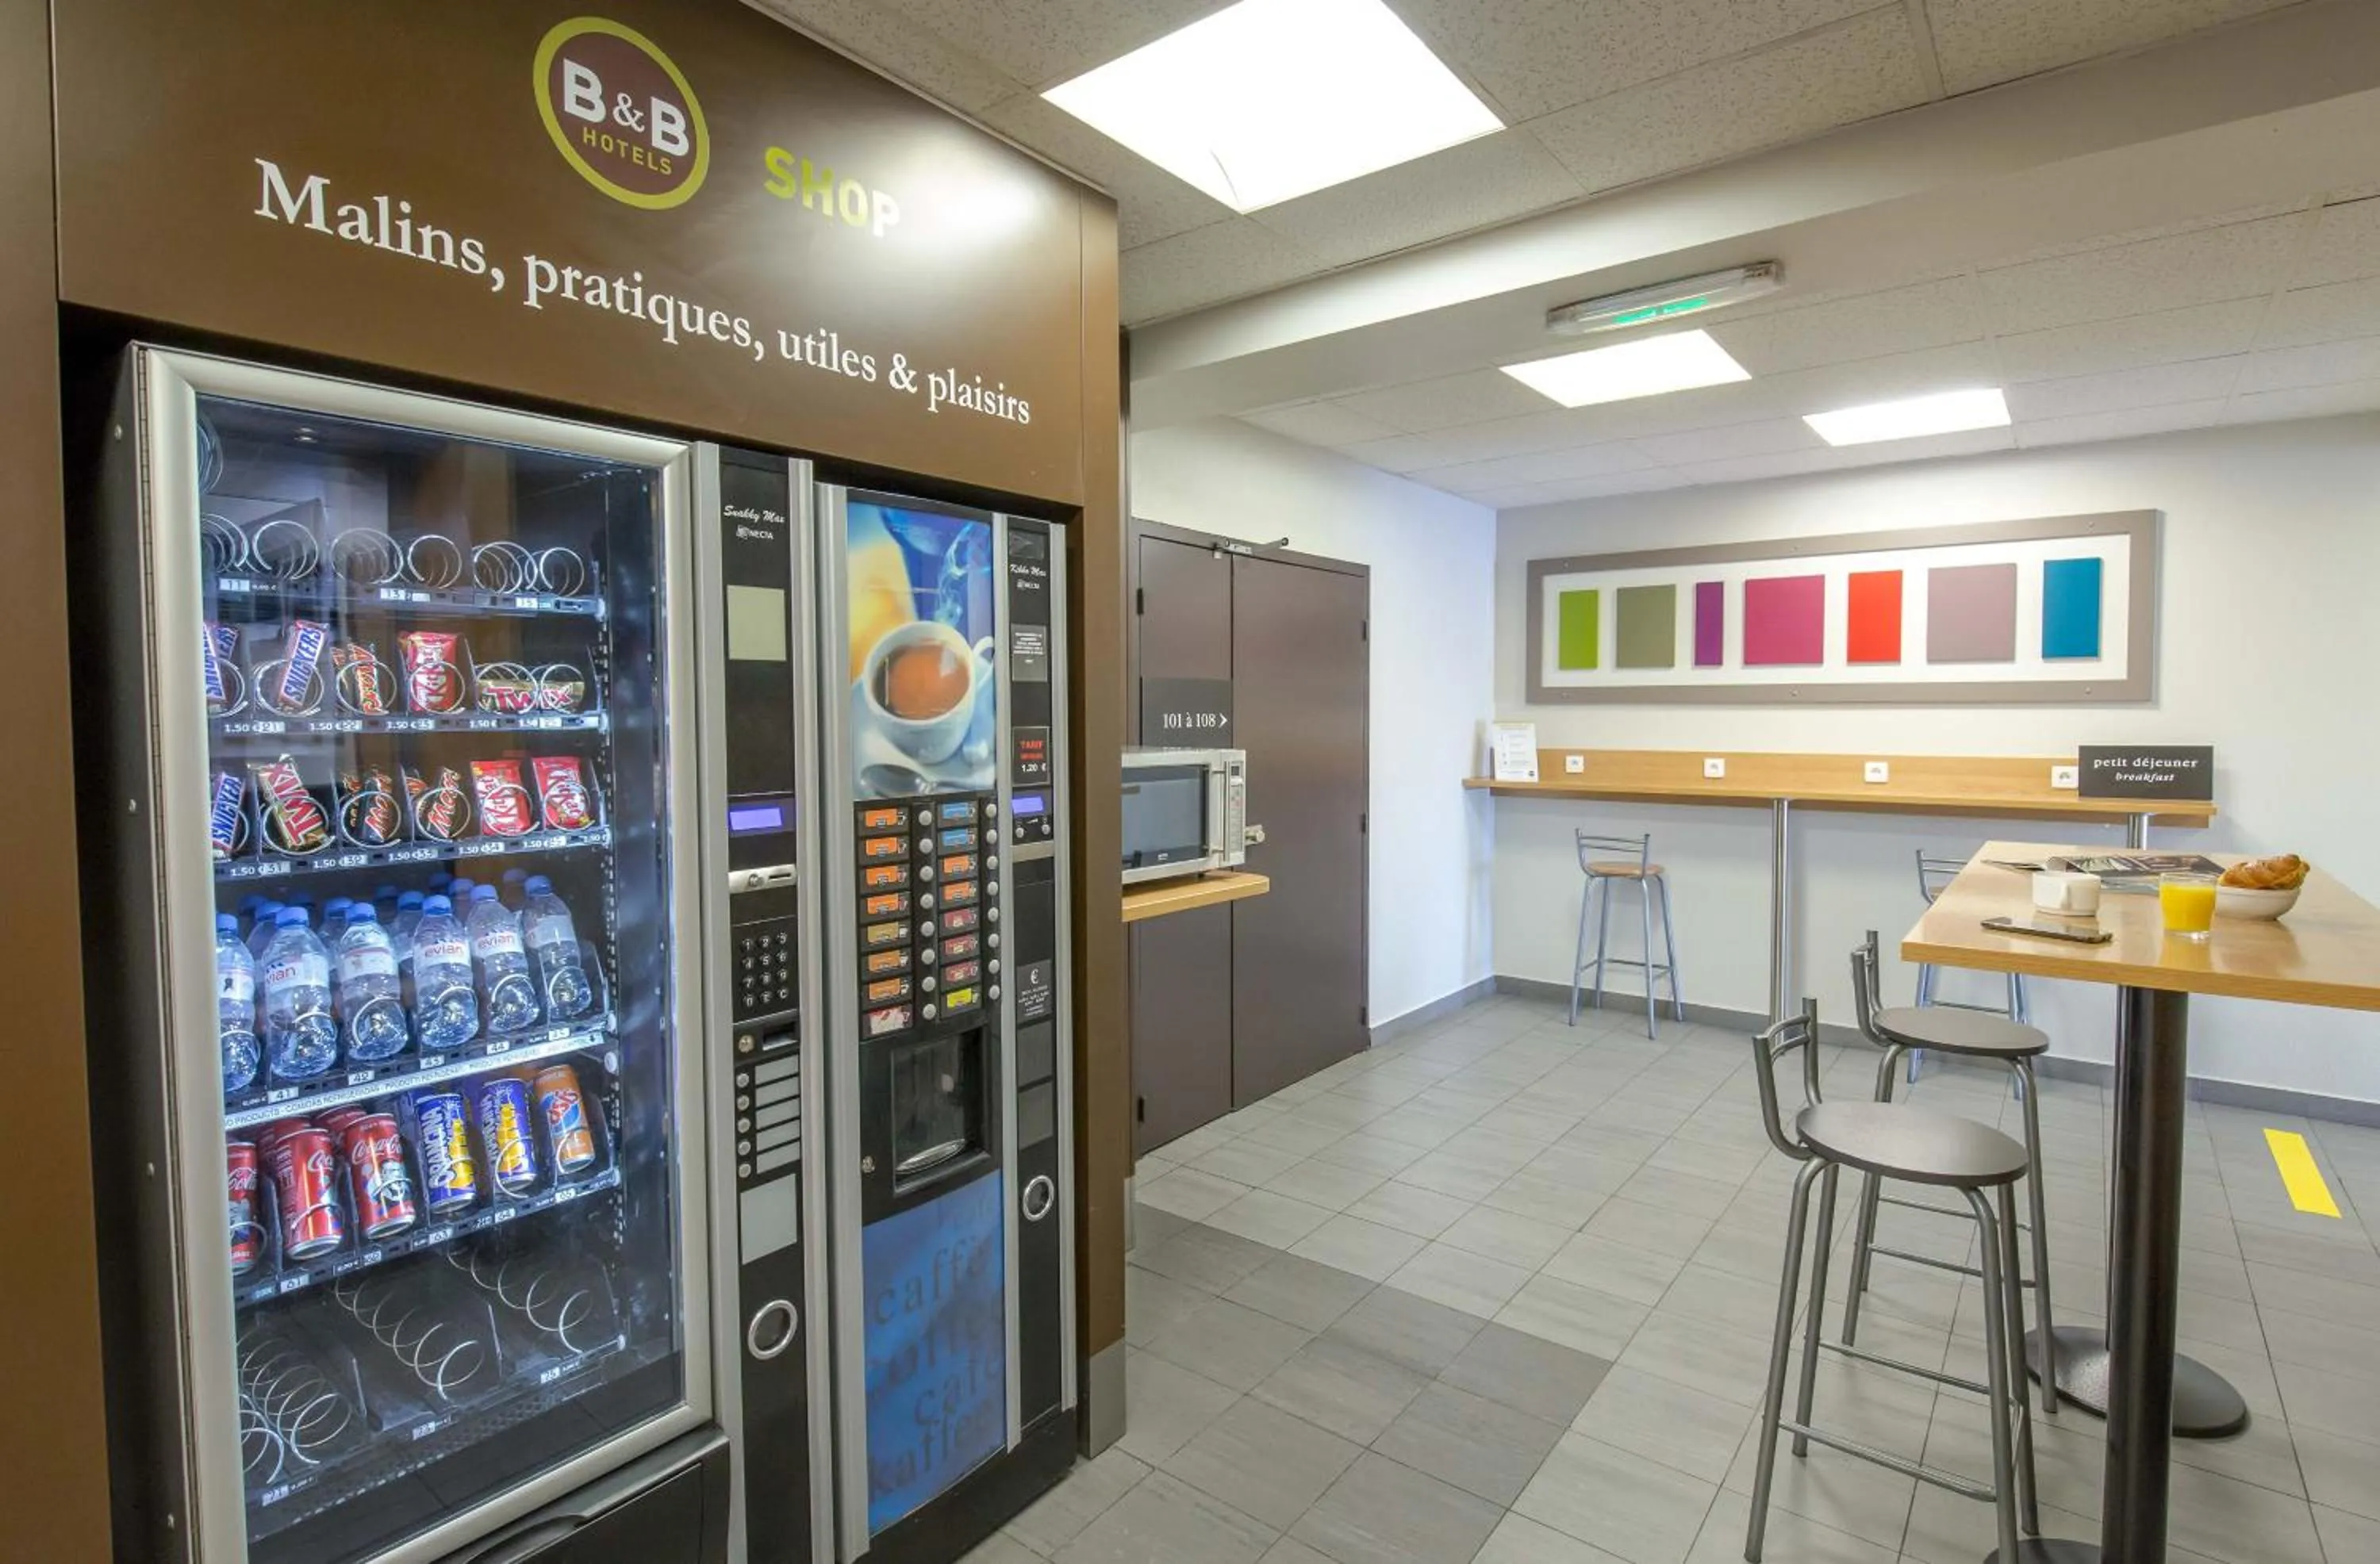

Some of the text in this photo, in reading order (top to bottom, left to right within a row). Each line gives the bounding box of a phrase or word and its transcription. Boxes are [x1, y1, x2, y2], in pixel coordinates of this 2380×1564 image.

[582, 127, 674, 176] HOTELS
[764, 145, 900, 237] SHOP
[253, 157, 1031, 424] Malins, pratiques, utiles & plaisirs
[1163, 711, 1216, 728] 101 à 108
[2094, 757, 2198, 770] petit déjeuner
[2115, 772, 2175, 783] breakfast
[231, 867, 255, 876] 1.50
[314, 859, 336, 868] 1.50
[266, 965, 297, 985] vian
